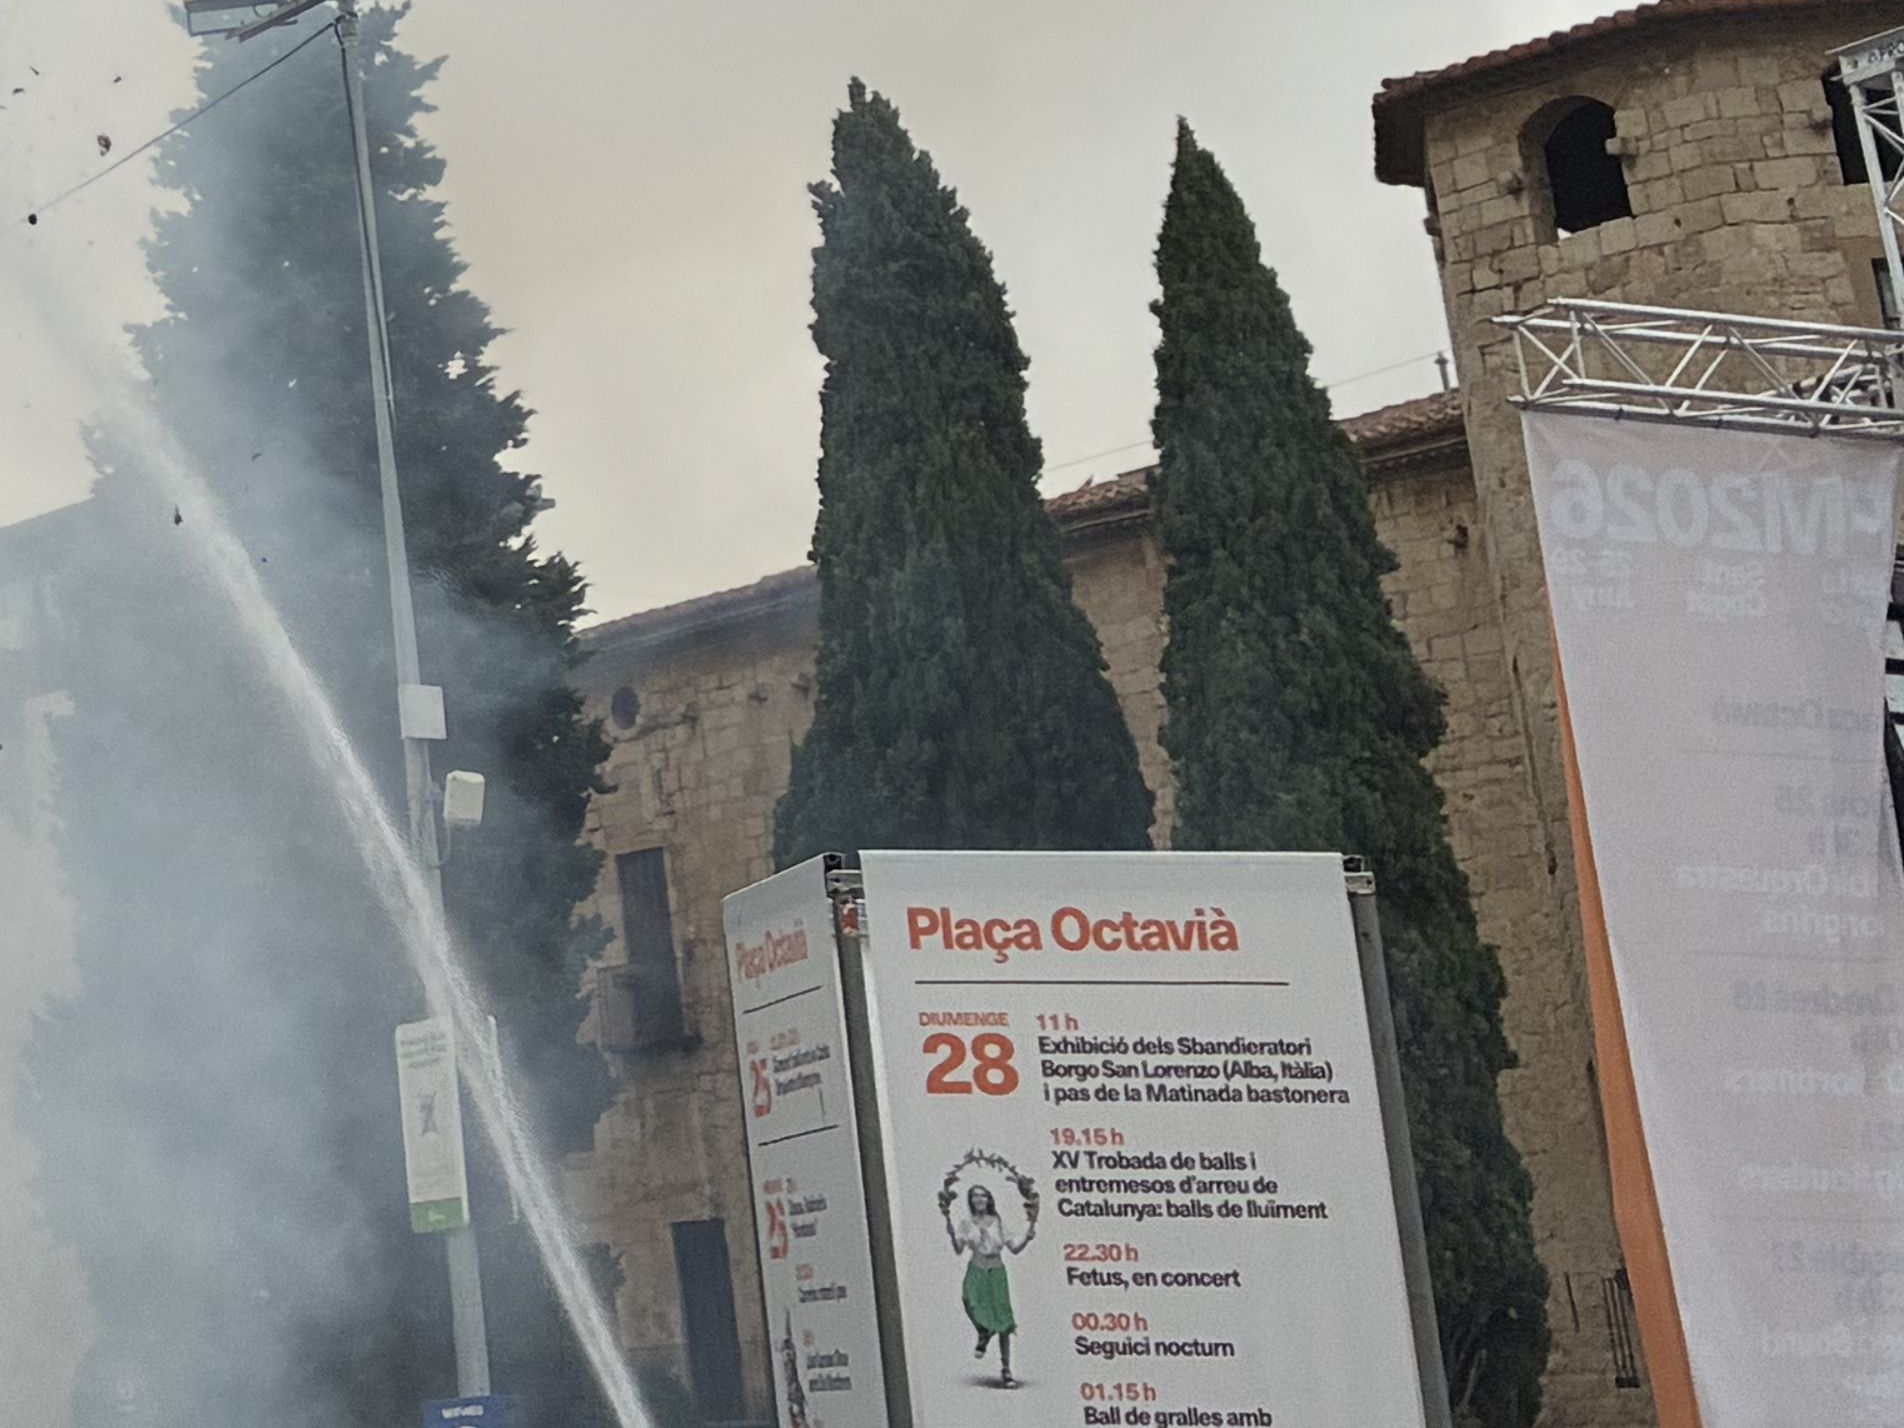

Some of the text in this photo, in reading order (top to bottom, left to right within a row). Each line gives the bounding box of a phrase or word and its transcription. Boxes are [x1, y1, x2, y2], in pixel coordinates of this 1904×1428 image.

[906, 905, 1240, 964] Plaça Octavià
[918, 1011, 1010, 1027] DIUMENGE
[1036, 1014, 1079, 1031] 11 h
[1038, 1036, 1312, 1056] Exhibició dels Sbandieratori
[922, 1032, 1020, 1096] 28
[1041, 1060, 1333, 1083] Borgo San Lorenzo (Alba, Itàlia)
[1054, 1087, 1091, 1105] pas
[1095, 1084, 1120, 1102] de
[1124, 1084, 1142, 1102] la
[1146, 1084, 1243, 1102] Matinada
[1247, 1085, 1350, 1104] bastonera
[1049, 1128, 1125, 1145] 19.15 h
[1052, 1151, 1080, 1170] XV
[1083, 1151, 1167, 1170] Trobada
[1170, 1152, 1195, 1170] de
[1199, 1152, 1247, 1170] balls
[1055, 1176, 1278, 1194] entremesos d'arreu de
[1057, 1199, 1163, 1222] Catalunya:
[1166, 1200, 1214, 1218] balls
[1217, 1200, 1242, 1218] de
[1063, 1243, 1139, 1262] 22.30 h
[1066, 1266, 1241, 1290] Fetus, en concert
[1071, 1312, 1148, 1332] 00.30 h
[1074, 1336, 1151, 1360] Seguici
[1080, 1382, 1157, 1401] 01.15 h
[1084, 1406, 1273, 1428] Ball de gralles amb
